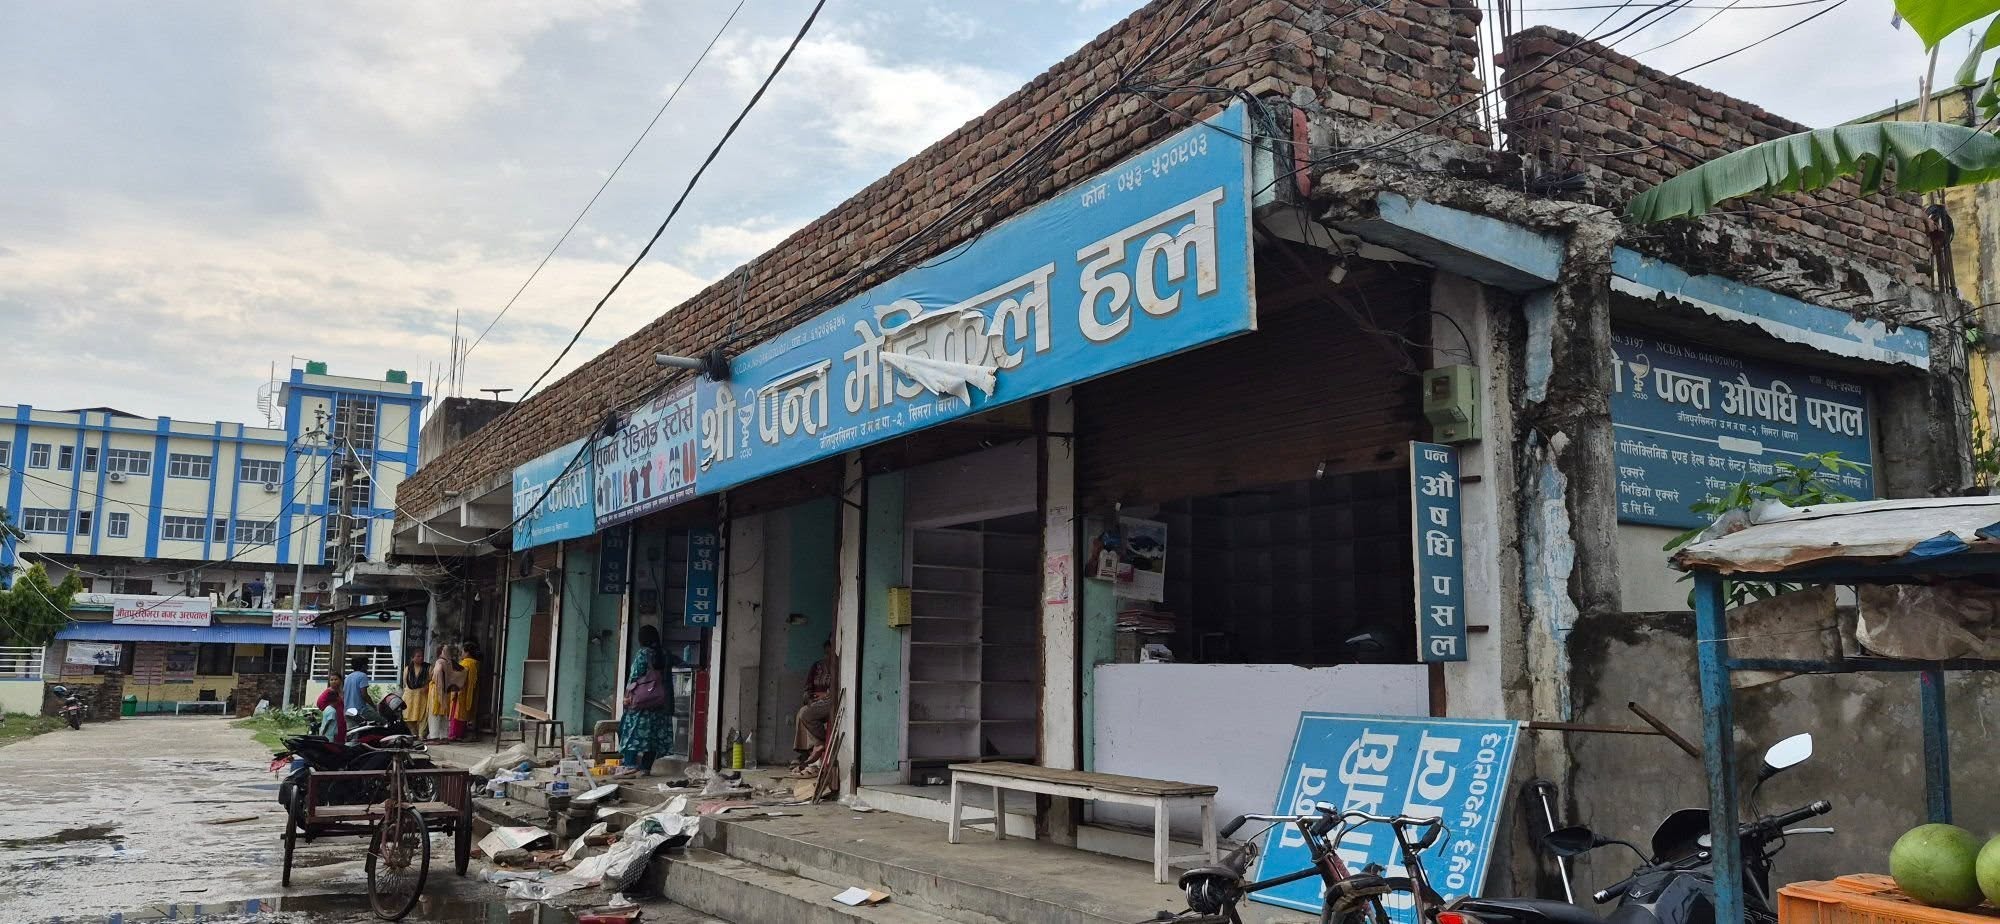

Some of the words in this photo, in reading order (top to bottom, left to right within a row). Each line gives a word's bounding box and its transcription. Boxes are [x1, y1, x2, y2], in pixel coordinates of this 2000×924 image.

[700, 384, 737, 472] श्री
[757, 358, 832, 444] पन्त
[1077, 186, 1224, 341] हल
[1625, 335, 1644, 349] 3197
[1656, 342, 1682, 357] NCDA
[1653, 367, 1712, 410] पन्त
[1719, 372, 1799, 425] औषधि
[1805, 397, 1864, 437] पसल
[908, 403, 932, 422] सिमरा
[622, 419, 659, 458] रेडिमेड
[662, 397, 694, 440] स्टोर्स
[1761, 424, 1779, 438] सिमरा
[1424, 448, 1449, 464] पन्त
[1671, 450, 1689, 465] एण्ड
[1691, 451, 1705, 468] हेल्थ
[1708, 453, 1726, 471] केयर
[1620, 466, 1645, 481] एक्सरे
[1655, 488, 1680, 504] एक्सरे
[179, 611, 208, 620] अस्पताल
